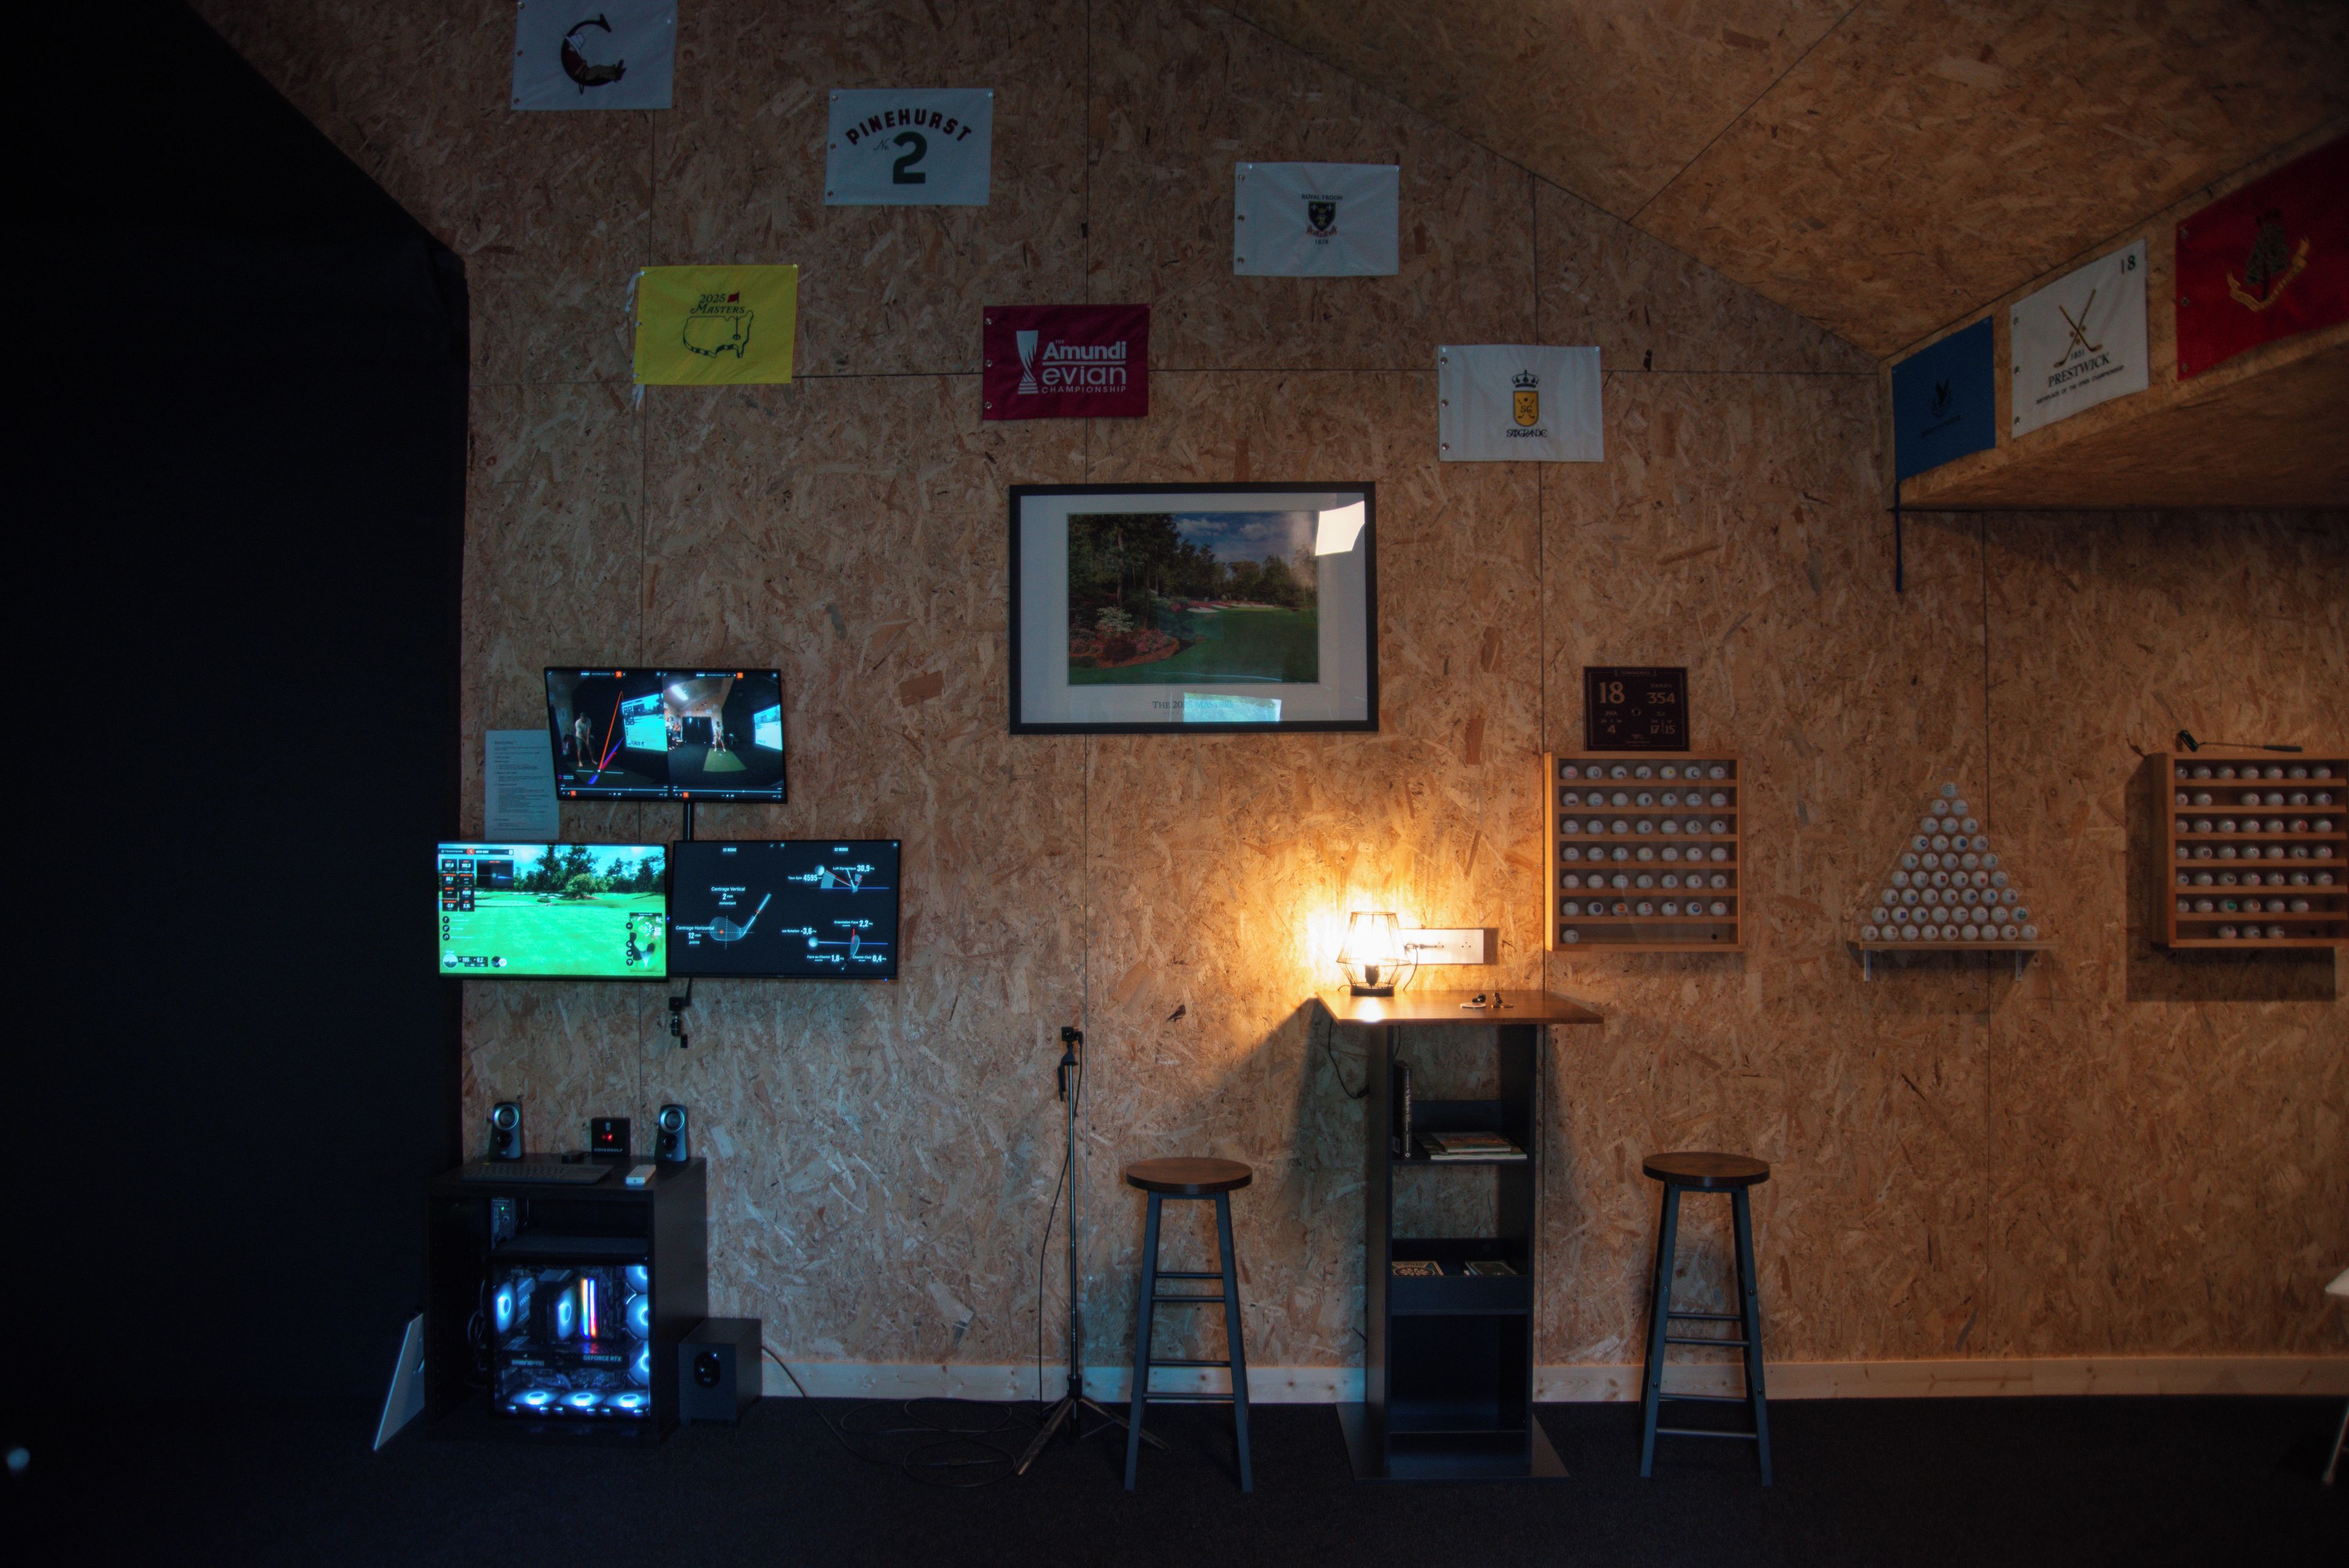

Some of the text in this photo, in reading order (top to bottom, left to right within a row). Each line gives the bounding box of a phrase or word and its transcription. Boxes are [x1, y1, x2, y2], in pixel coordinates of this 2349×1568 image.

[845, 108, 971, 146] PINEHURST
[892, 131, 927, 184] 2
[2121, 255, 2136, 274] 18
[700, 293, 725, 303] 2025
[1042, 341, 1126, 360] Amundi
[1042, 366, 1126, 385] evian
[2047, 352, 2110, 387] PRESTWICK
[1599, 681, 1625, 704] 18
[1646, 692, 1676, 704] 354
[1606, 724, 1616, 734] 4
[1650, 724, 1675, 734] 17 15
[859, 920, 869, 928] 2,2
